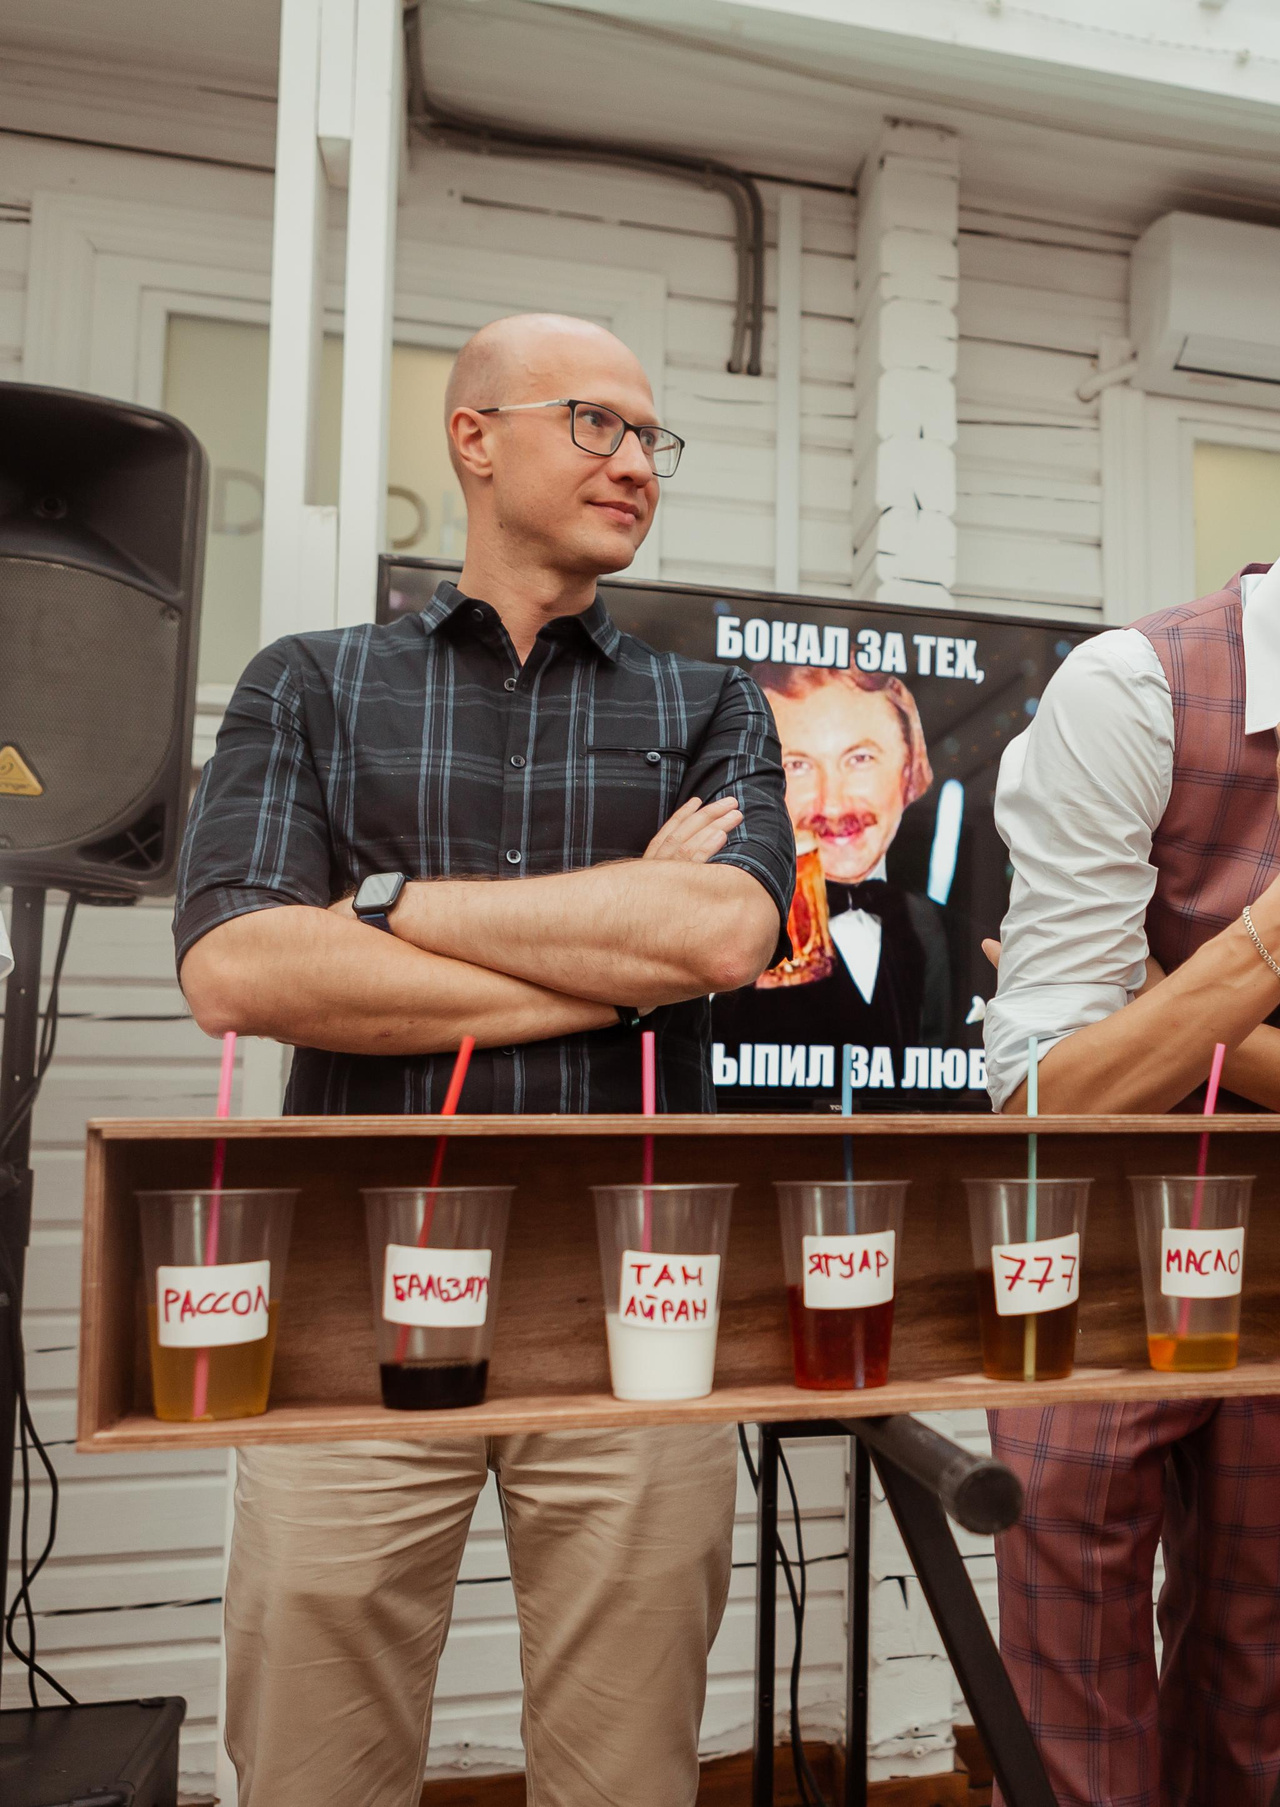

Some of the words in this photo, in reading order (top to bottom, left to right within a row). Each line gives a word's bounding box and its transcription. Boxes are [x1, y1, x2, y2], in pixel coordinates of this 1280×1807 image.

[716, 615, 850, 669] БОКАЛ
[856, 628, 907, 674] ЗА
[912, 634, 985, 684] ТЕХ,
[712, 1042, 836, 1088] ЫПИЛ
[849, 1045, 896, 1089] ЗА
[900, 1046, 988, 1090] ЛЮБ
[629, 1263, 704, 1288] ТАН
[808, 1249, 890, 1279] ЯГУАР
[1000, 1253, 1078, 1294] 777
[1165, 1248, 1241, 1276] МАСЛО
[163, 1284, 270, 1323] РАССОЛ
[624, 1294, 708, 1324] АЙРАН
